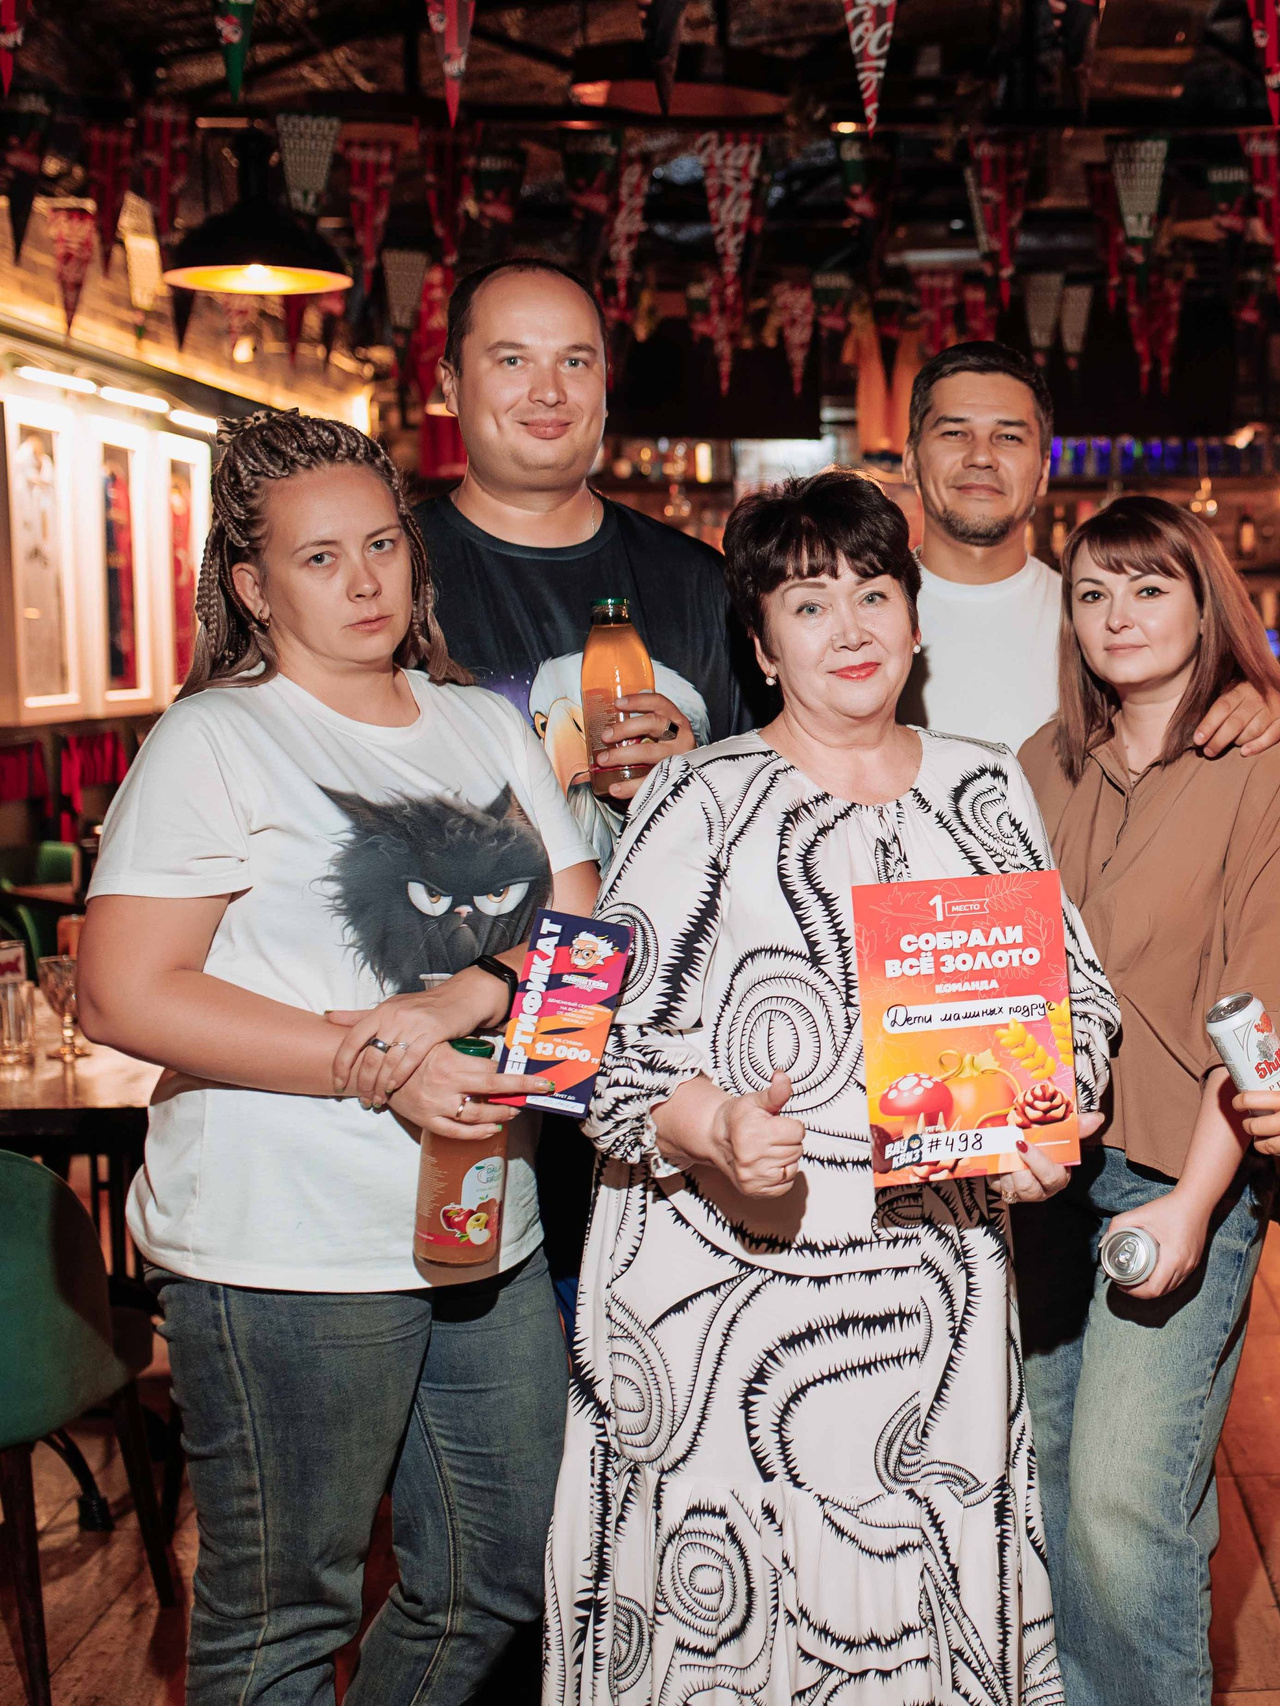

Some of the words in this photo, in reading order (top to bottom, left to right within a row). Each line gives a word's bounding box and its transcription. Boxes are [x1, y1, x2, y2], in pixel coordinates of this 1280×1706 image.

[929, 894, 943, 922] 1
[951, 903, 980, 913] МЕСТО
[900, 925, 1023, 953] СОБРАЛИ
[885, 952, 936, 978] ВСЁ
[939, 947, 1041, 973] ЗОЛОТО
[504, 918, 562, 1075] ЕРТИФИКАТ
[935, 978, 999, 994] КОМАНДА
[886, 1003, 933, 1028] Дети
[940, 1005, 1004, 1022] маминых
[535, 1041, 554, 1056] 13
[555, 1045, 591, 1062] 000
[927, 1133, 983, 1153] #498
